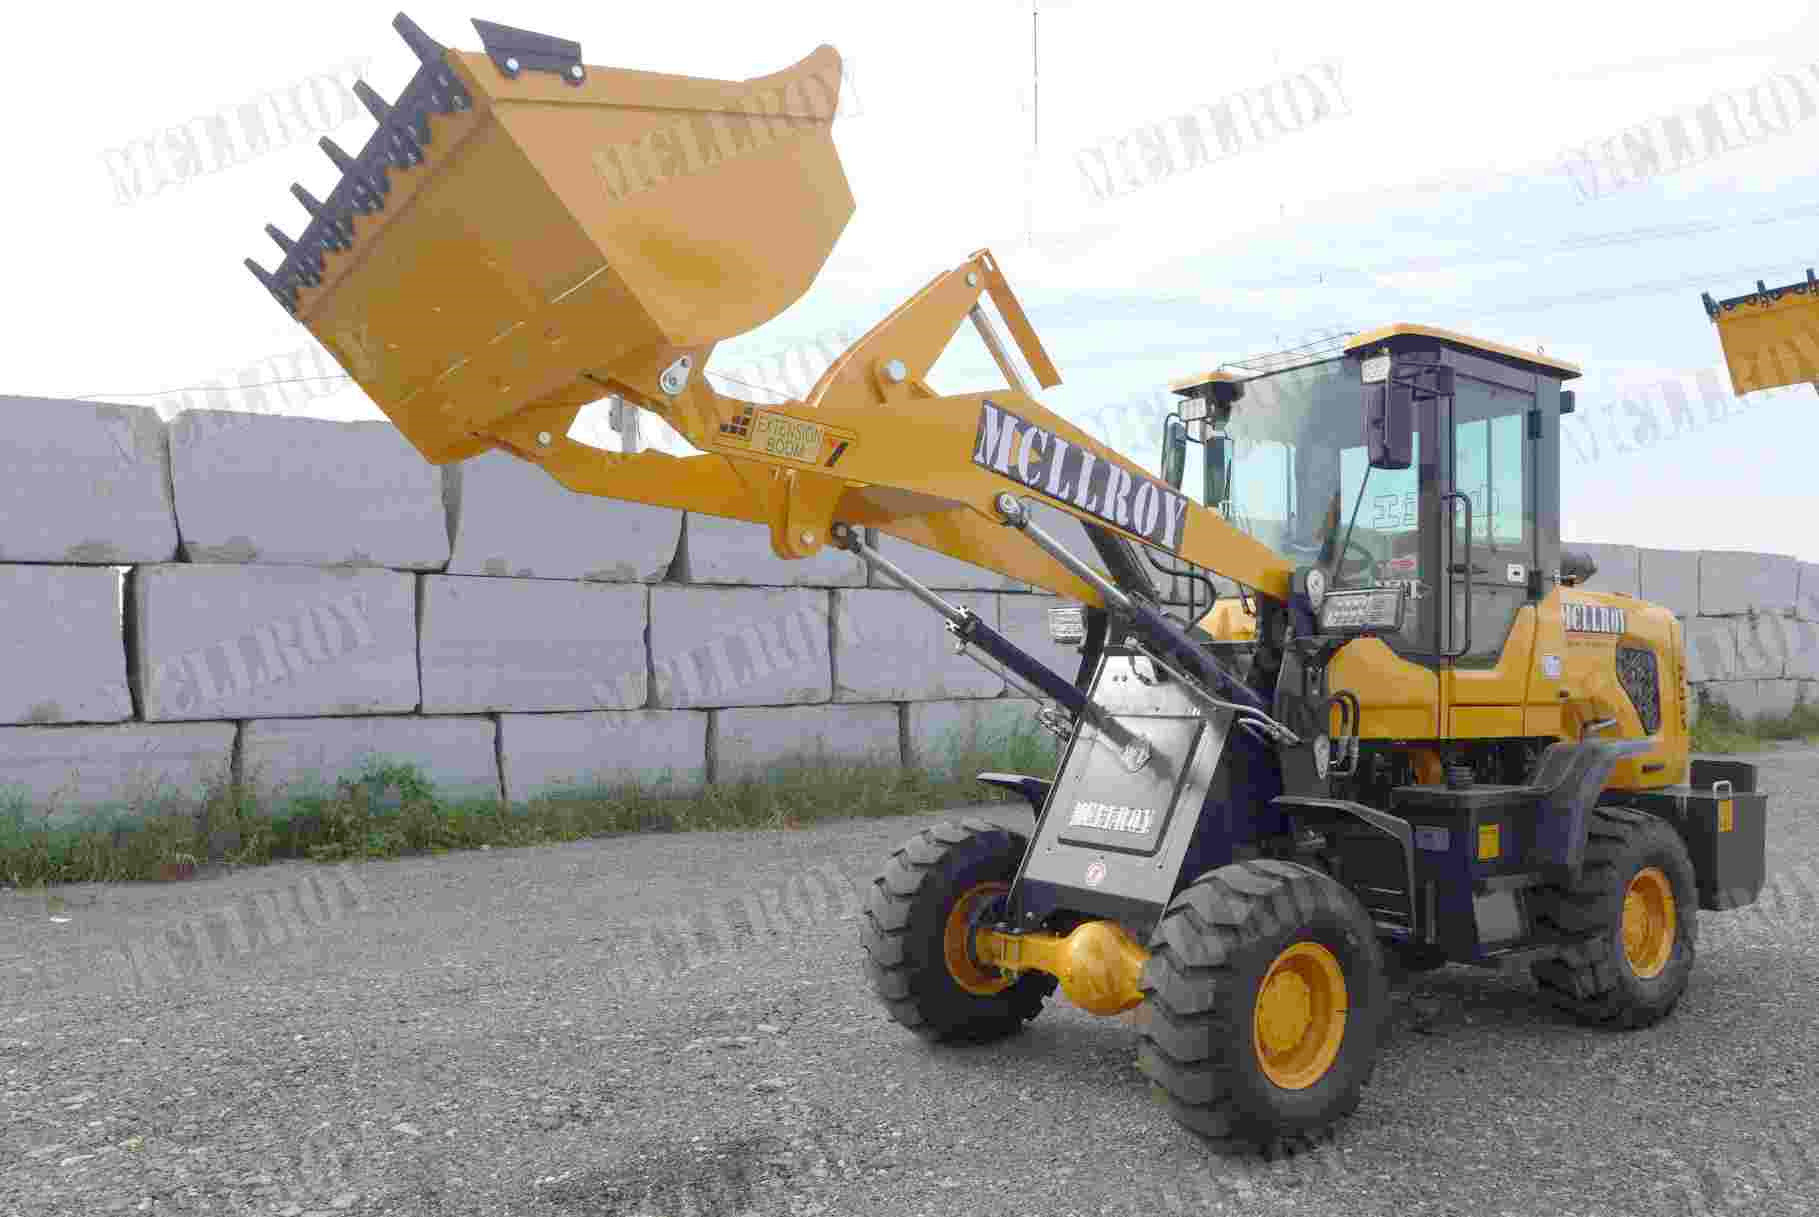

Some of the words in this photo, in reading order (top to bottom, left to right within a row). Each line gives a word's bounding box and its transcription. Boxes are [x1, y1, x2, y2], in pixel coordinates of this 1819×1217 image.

[757, 414, 823, 442] EXTENSION
[765, 436, 806, 456] BOOM
[973, 403, 1188, 549] MCLLROY
[1561, 601, 1625, 633] MCLLROY
